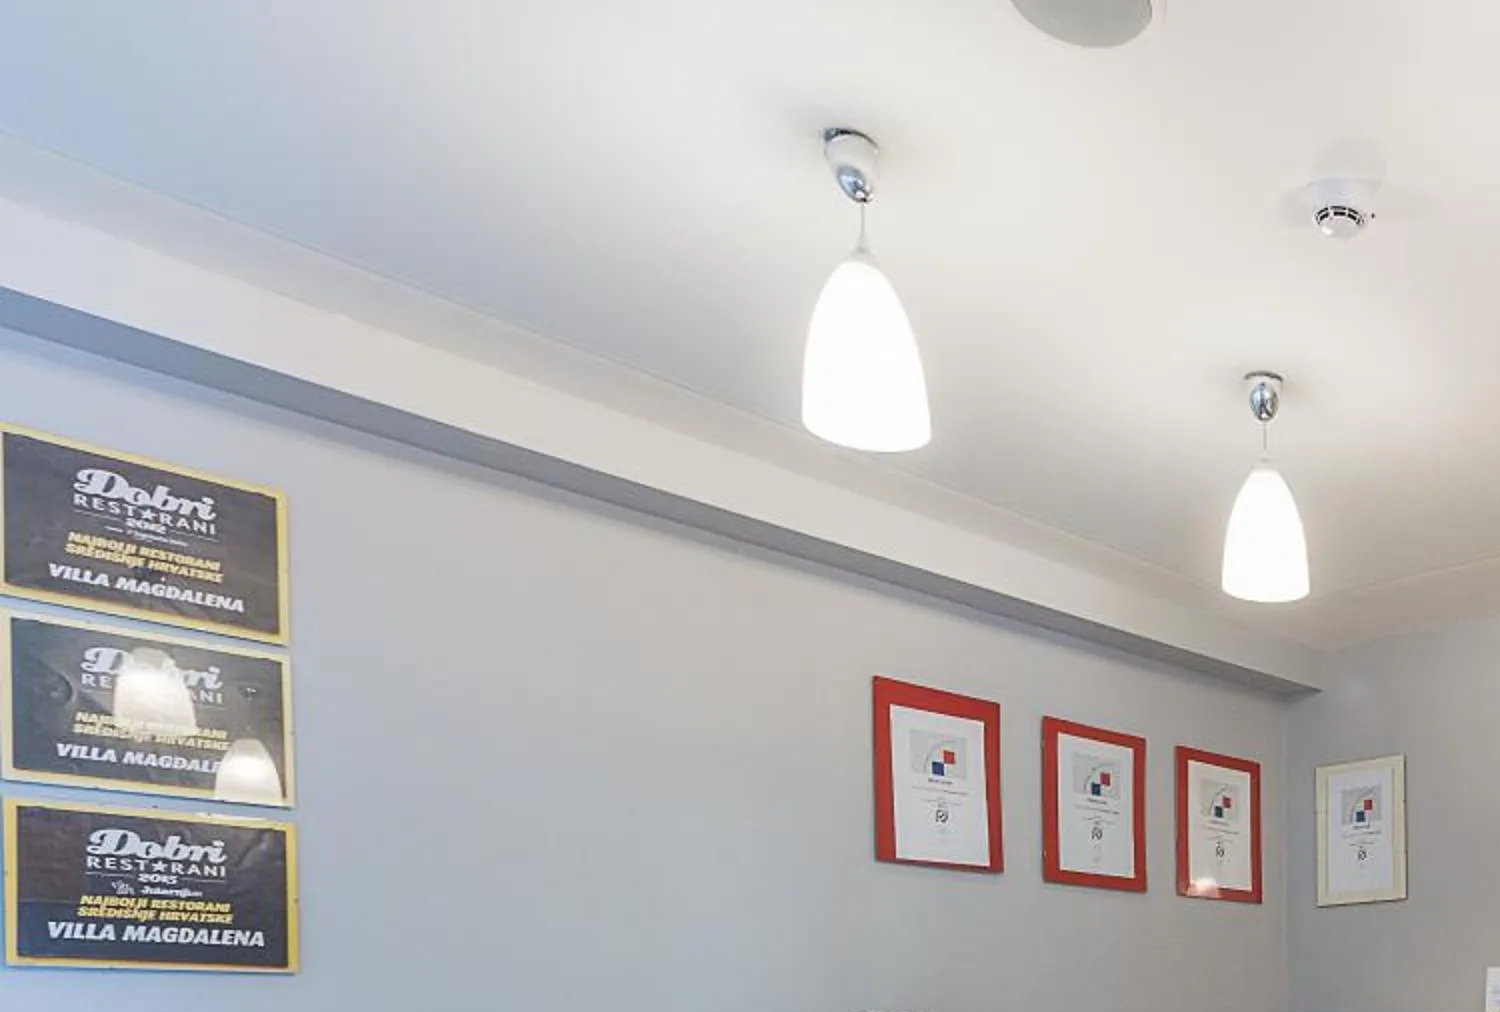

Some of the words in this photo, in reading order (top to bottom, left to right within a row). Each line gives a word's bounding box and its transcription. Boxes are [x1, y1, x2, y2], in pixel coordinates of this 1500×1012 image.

[73, 468, 217, 521] Dobri
[48, 562, 110, 588] VILLA
[114, 576, 245, 613] MAGDALENA
[55, 743, 117, 763] VILLA
[122, 750, 221, 774] MAGDALE
[86, 828, 227, 864] Dobri
[48, 921, 115, 942] VILLA
[122, 925, 265, 948] MAGDALENA
